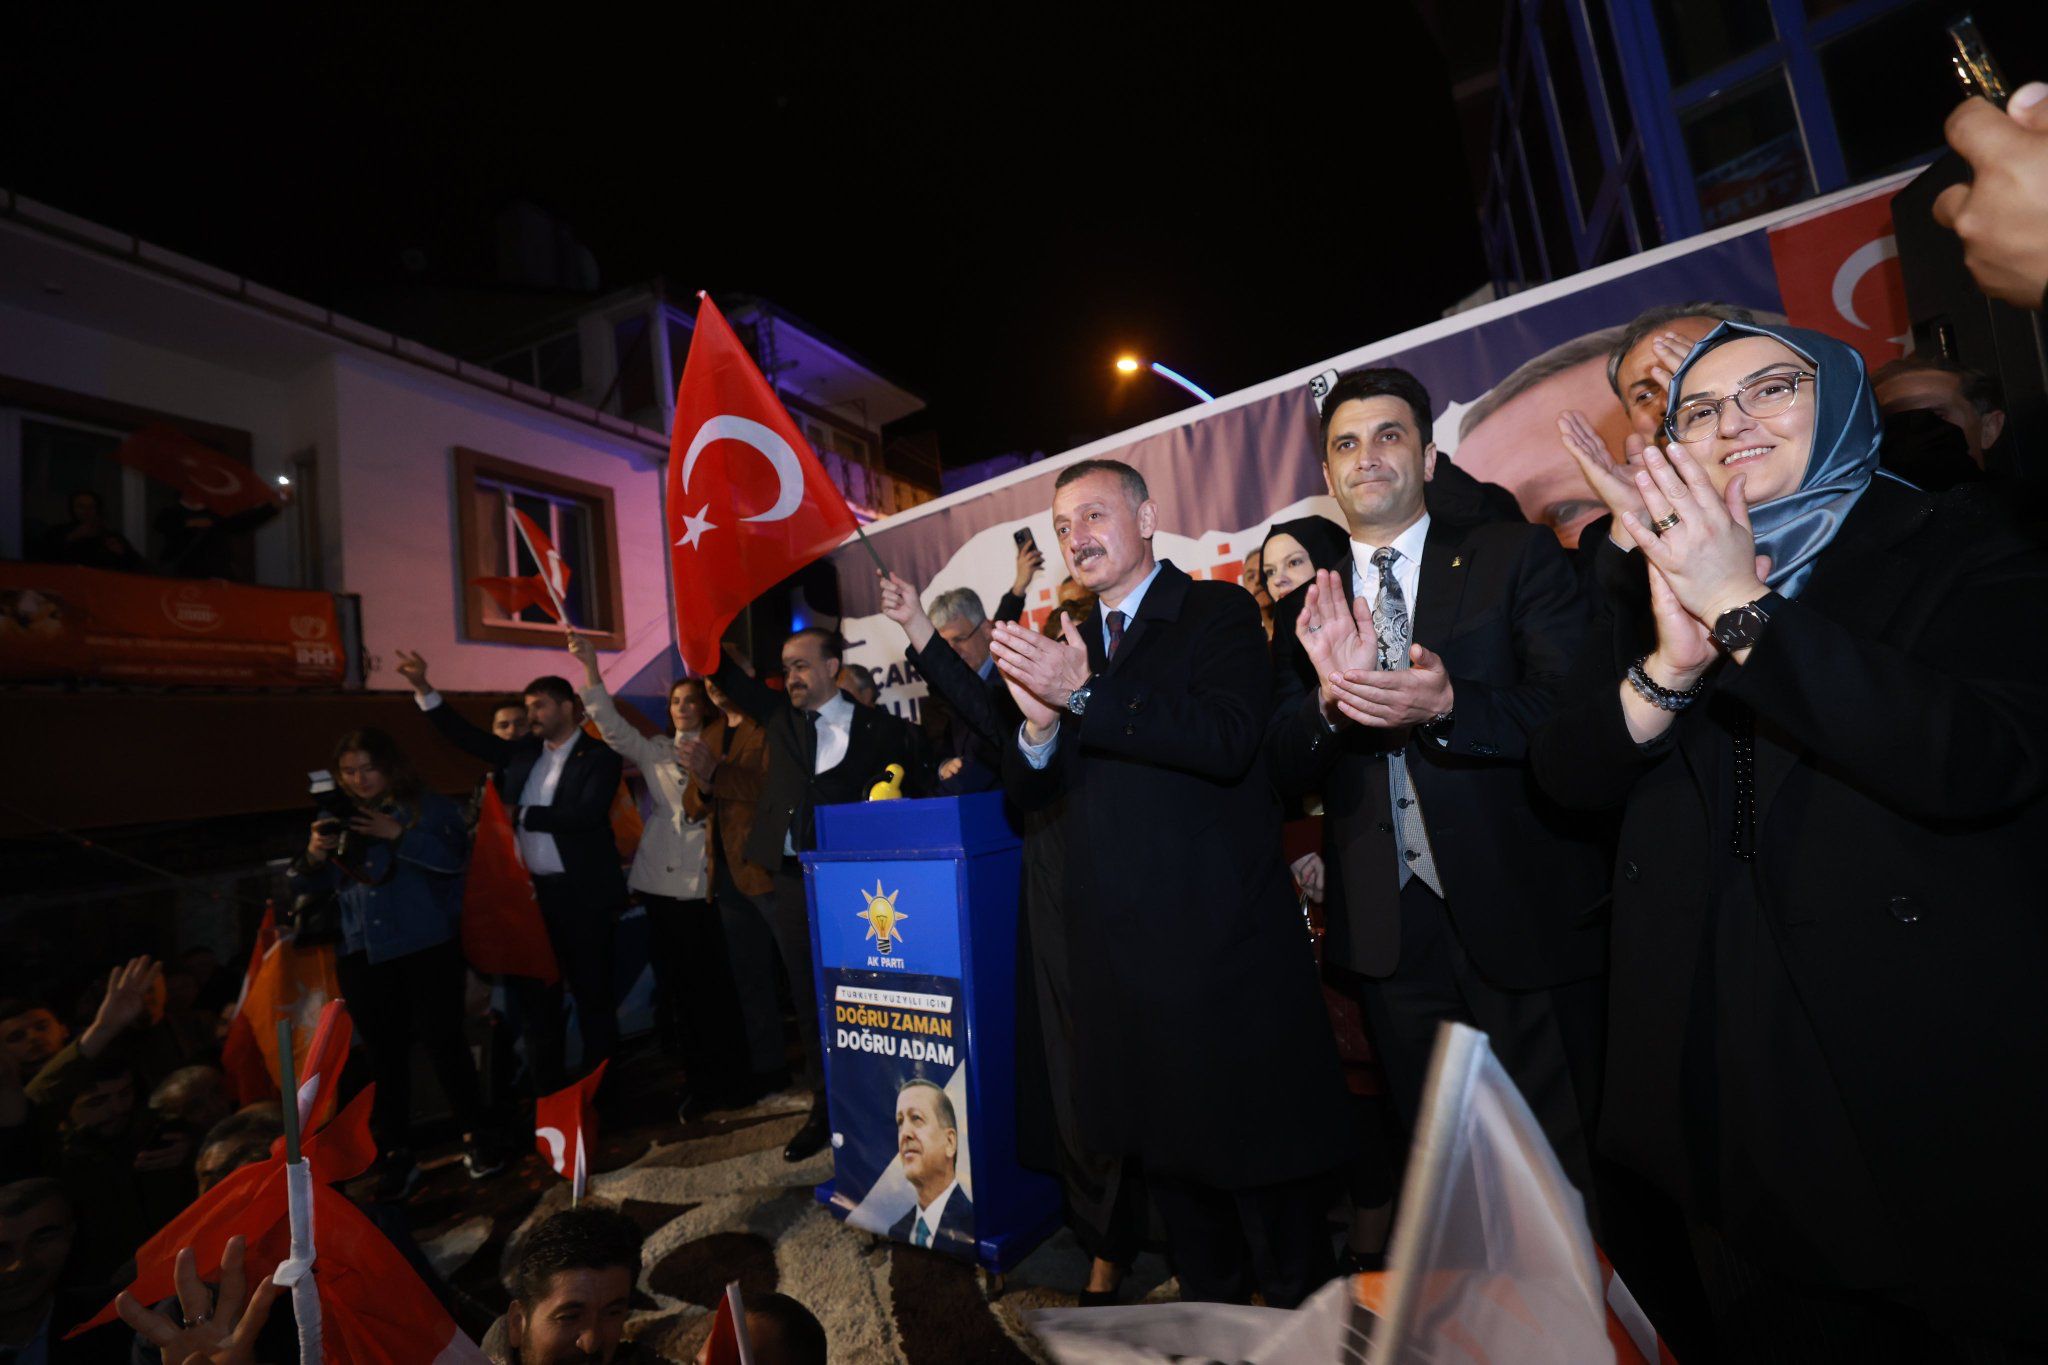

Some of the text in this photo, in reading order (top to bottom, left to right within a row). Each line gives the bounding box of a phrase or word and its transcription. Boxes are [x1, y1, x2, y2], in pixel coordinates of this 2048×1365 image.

[867, 956, 879, 967] AK
[836, 1005, 952, 1038] DOĞRU ZAMAN
[837, 1028, 954, 1066] DOĞRU ADAM
